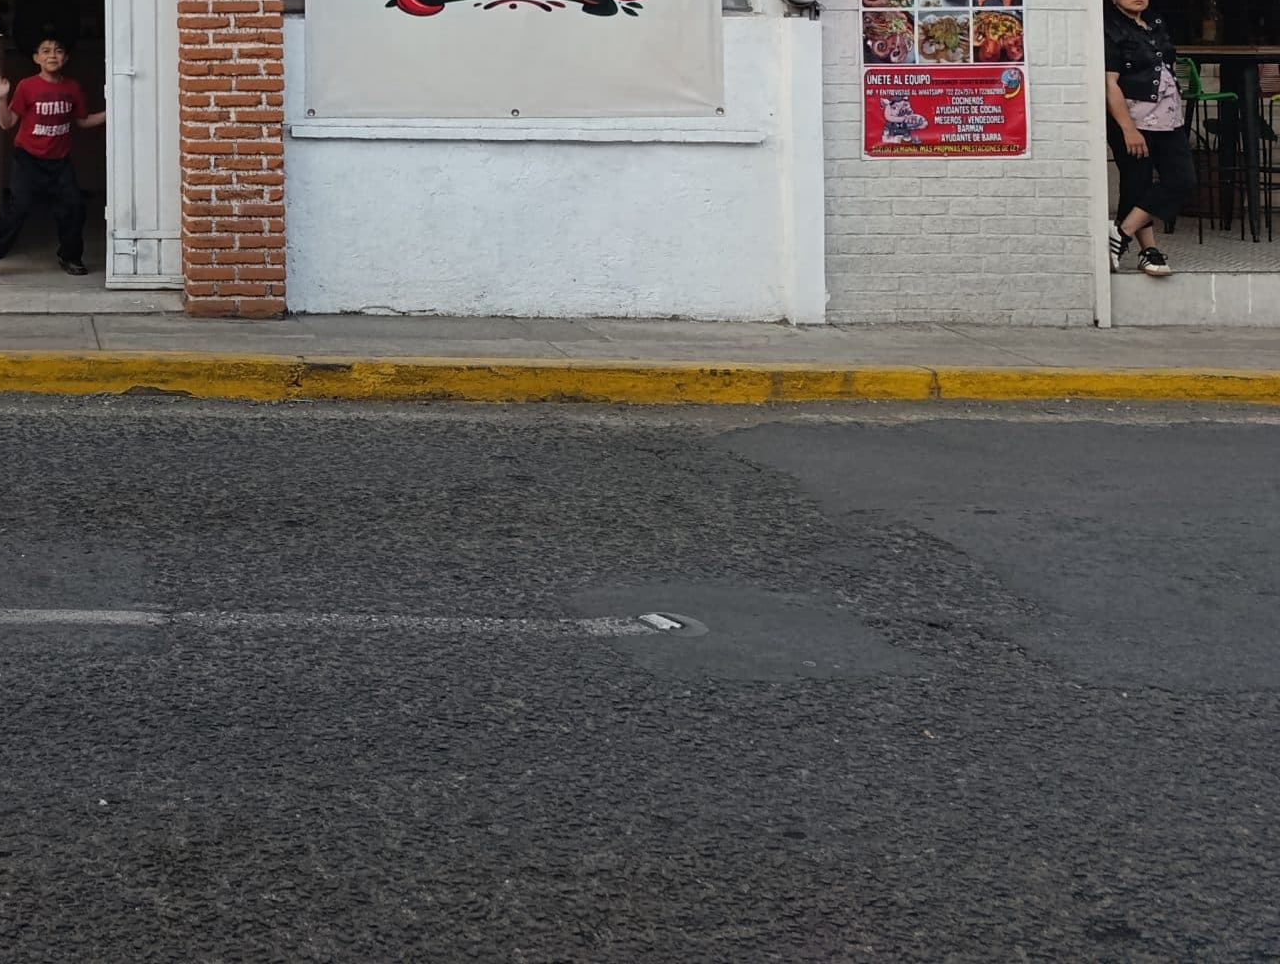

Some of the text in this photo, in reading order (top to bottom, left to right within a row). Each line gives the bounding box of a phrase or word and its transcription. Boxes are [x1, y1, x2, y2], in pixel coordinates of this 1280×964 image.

[893, 75, 903, 85] AL
[905, 74, 931, 85] EQUIPO
[951, 97, 984, 105] COCINEROS
[935, 105, 1001, 114] AYUDANTES DE COCINA
[934, 116, 962, 124] MESEROS
[968, 115, 1004, 124] VENDEDORES
[941, 133, 1002, 142] AYUDANTE DE BARRA
